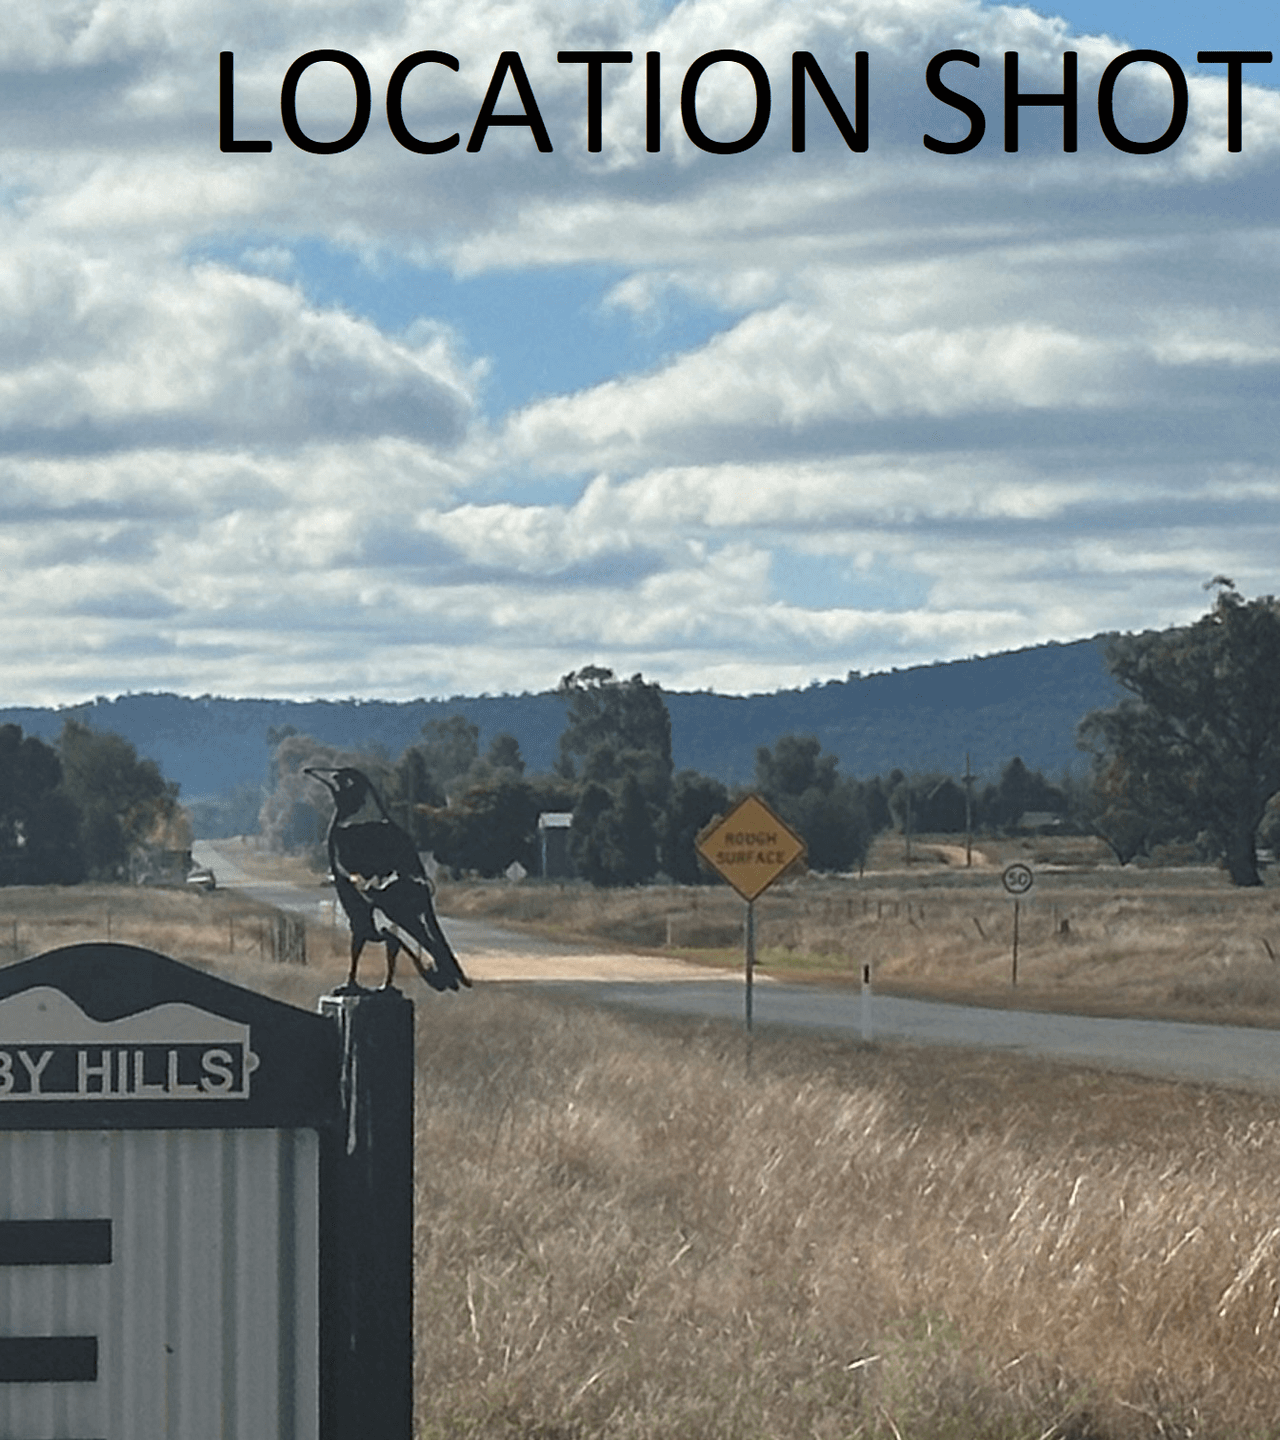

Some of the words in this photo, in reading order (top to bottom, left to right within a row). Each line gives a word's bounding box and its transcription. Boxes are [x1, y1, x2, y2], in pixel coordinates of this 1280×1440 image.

[725, 832, 778, 845] ROUGH
[716, 850, 785, 864] SURFACE
[1009, 872, 1028, 886] 50
[78, 1049, 234, 1093] HILLS
